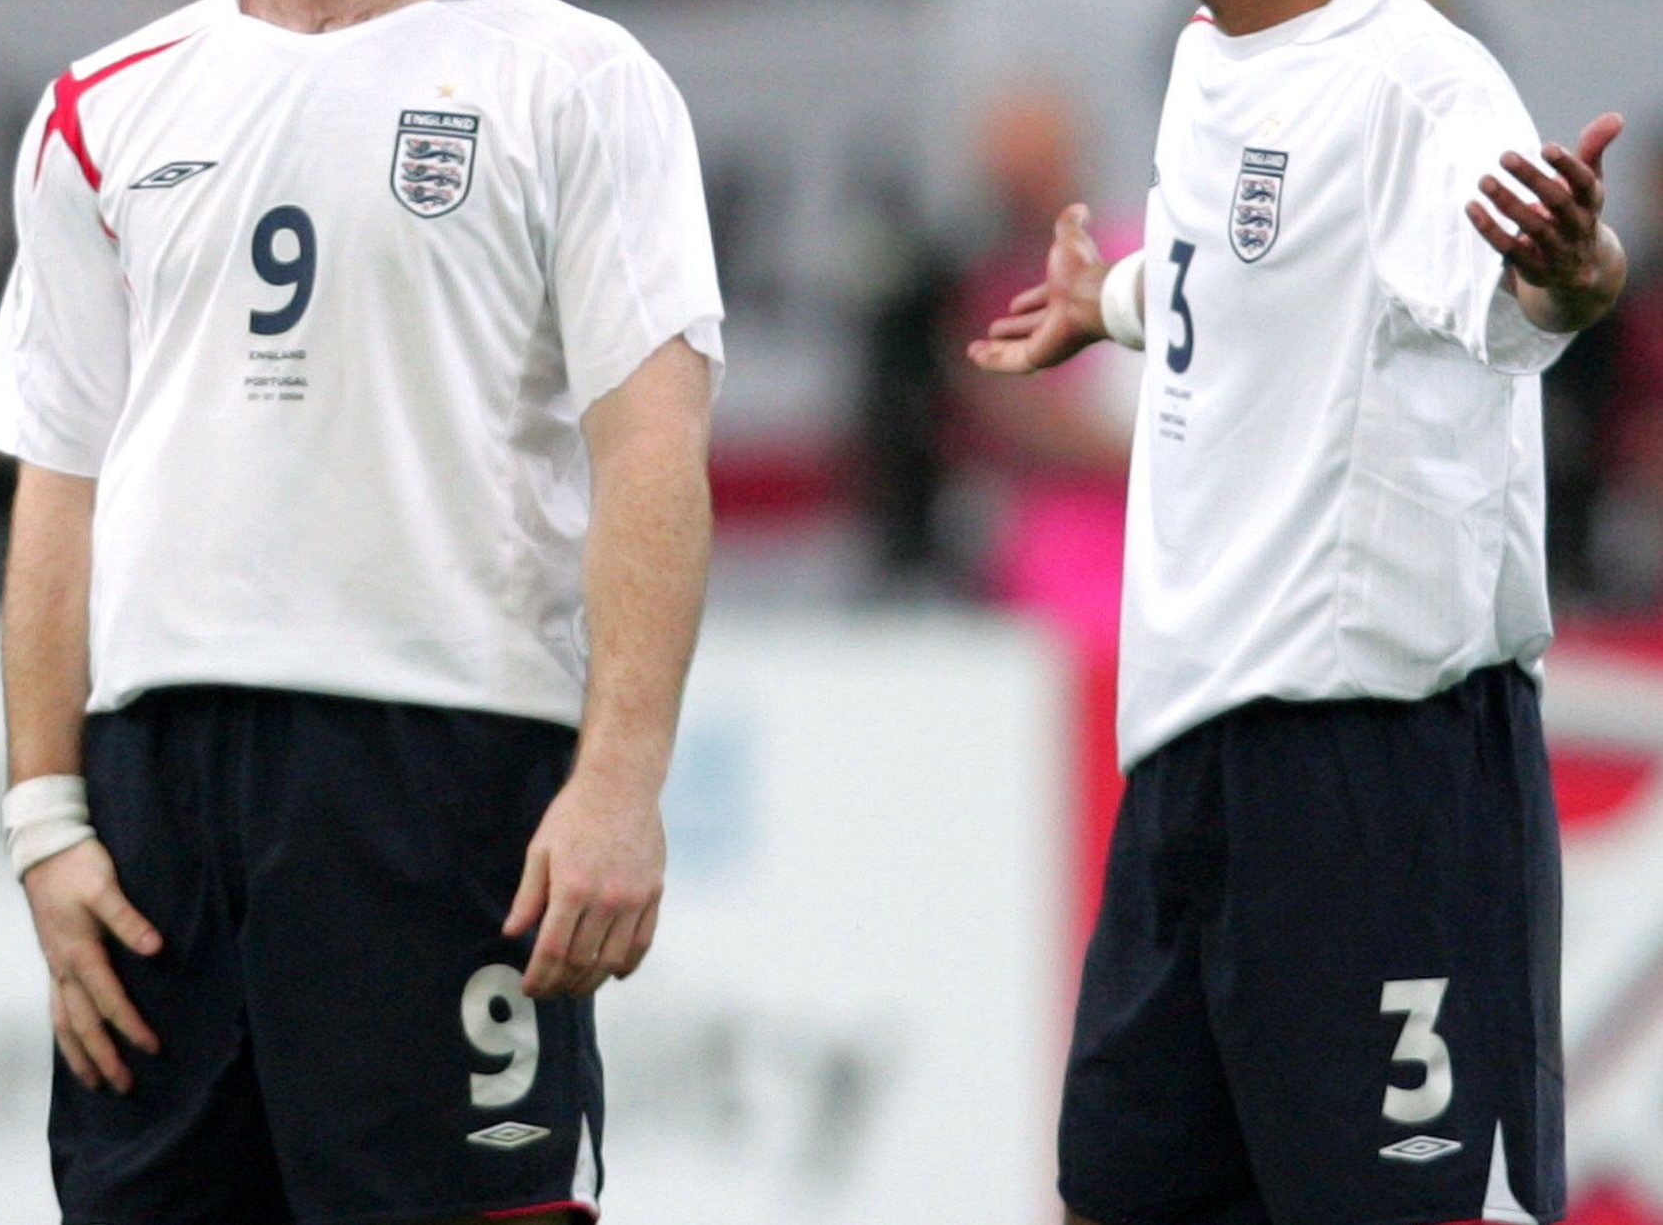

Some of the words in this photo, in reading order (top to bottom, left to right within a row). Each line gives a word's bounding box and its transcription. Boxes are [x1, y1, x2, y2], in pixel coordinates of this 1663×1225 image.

[403, 113, 476, 132] ENGLAND
[249, 204, 317, 335] 9
[1166, 239, 1196, 374] 3
[461, 963, 540, 1109] 9
[1379, 977, 1453, 1124] 3
